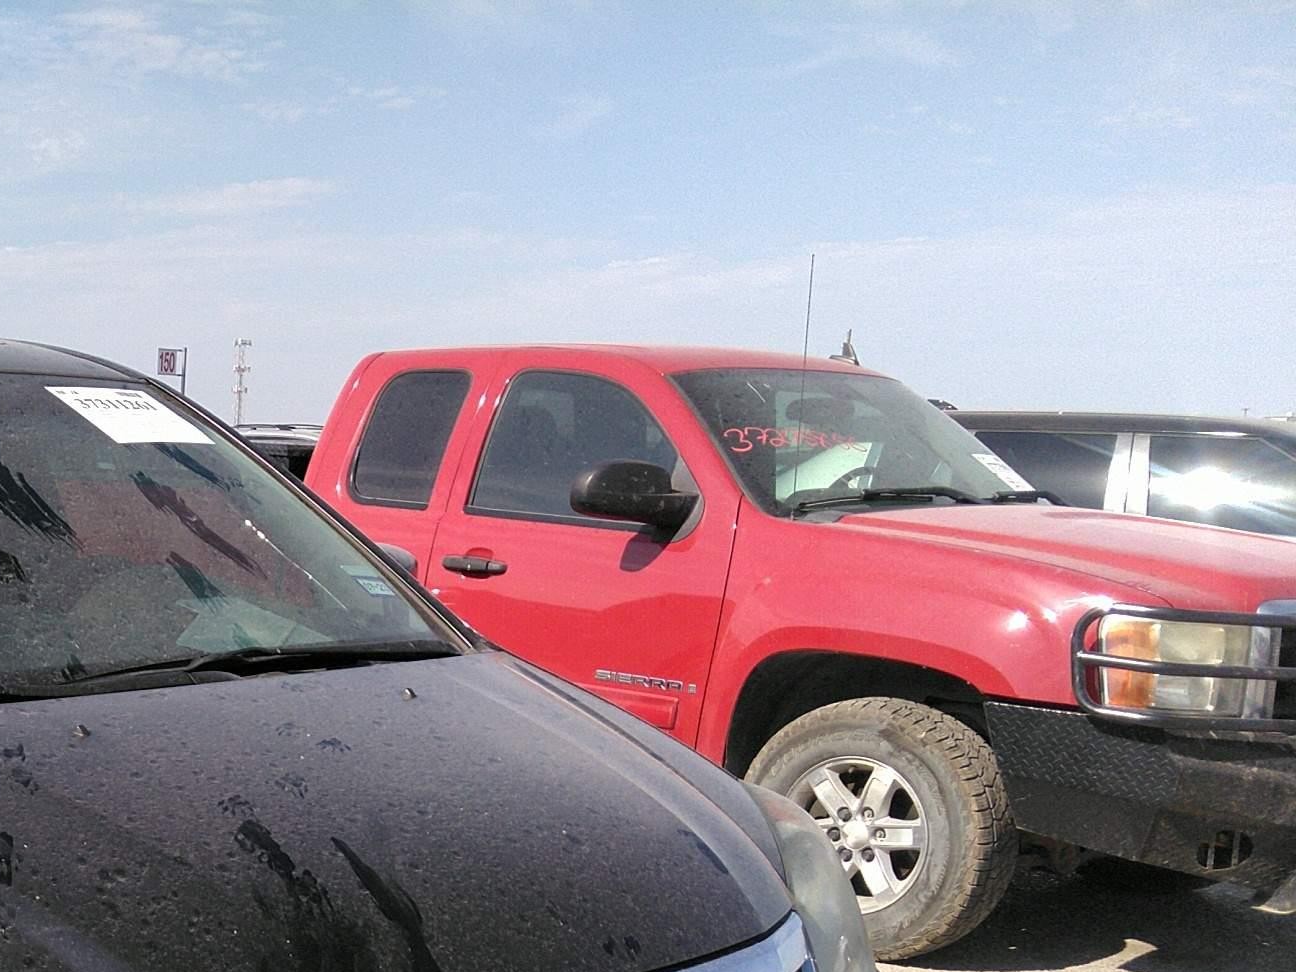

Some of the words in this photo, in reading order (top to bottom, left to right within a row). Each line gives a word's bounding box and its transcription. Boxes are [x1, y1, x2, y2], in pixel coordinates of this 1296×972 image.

[160, 351, 176, 373] 150
[73, 398, 158, 411] 37311261
[595, 669, 683, 690] SIERRA
